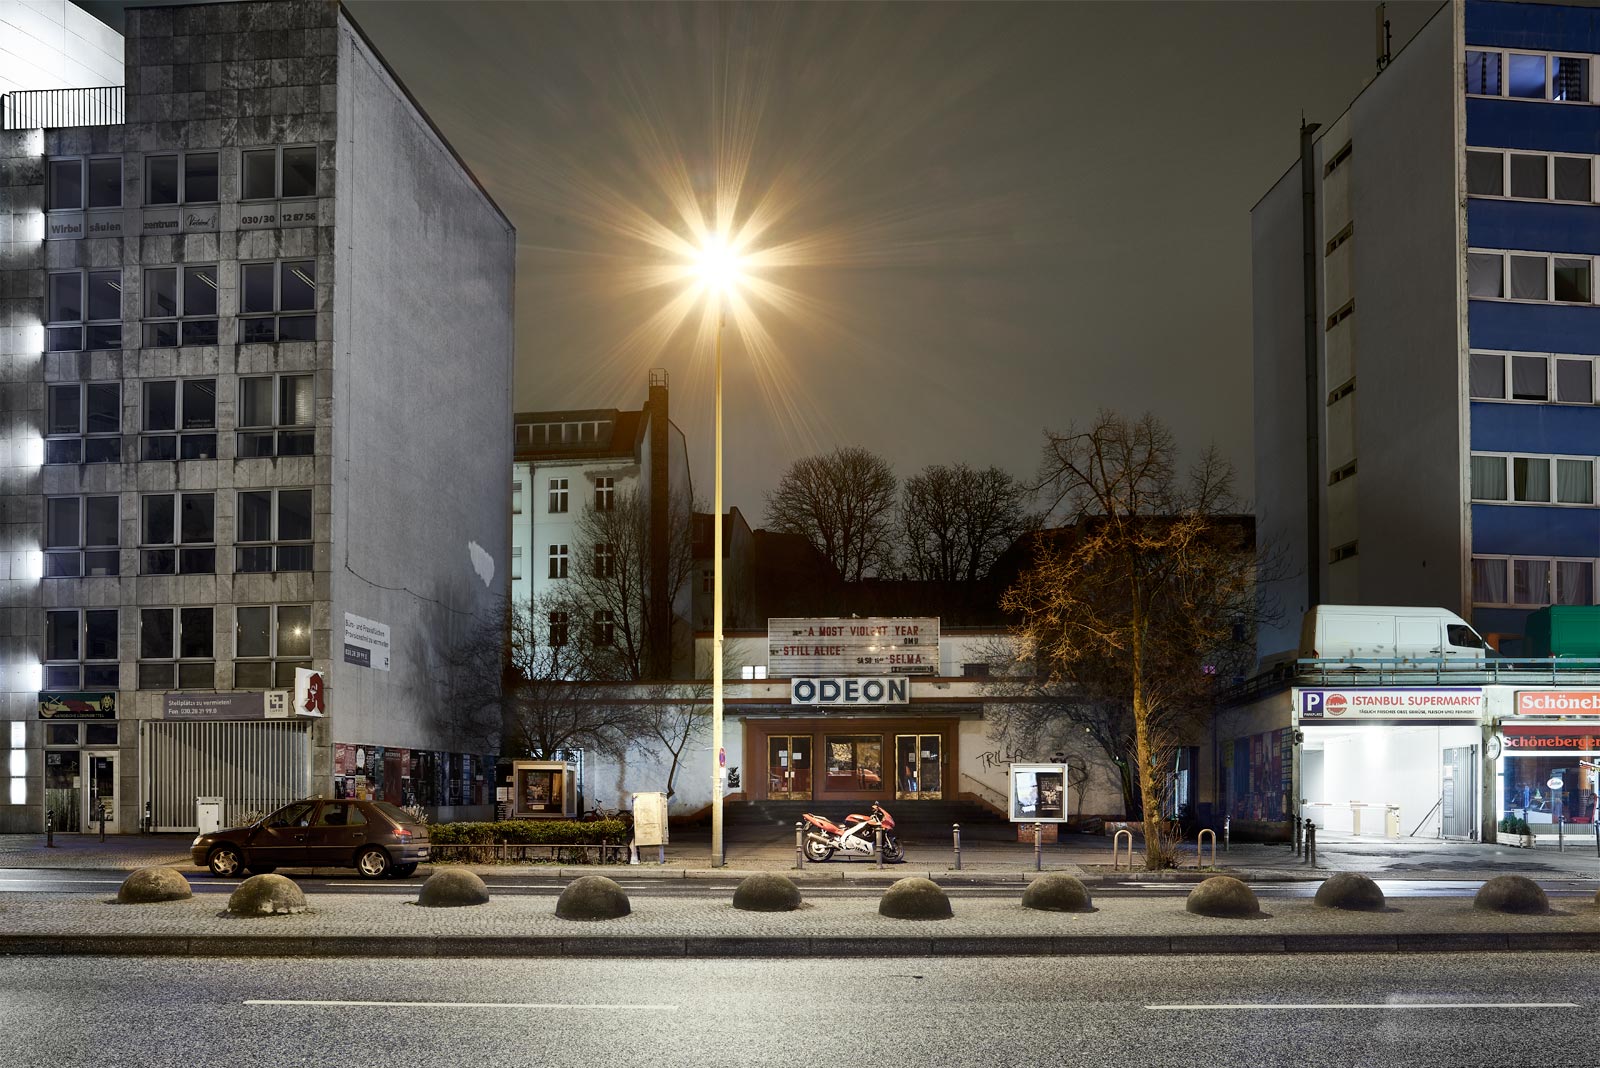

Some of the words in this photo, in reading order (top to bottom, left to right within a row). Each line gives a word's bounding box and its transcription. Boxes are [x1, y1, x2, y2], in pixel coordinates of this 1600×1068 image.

[241, 214, 275, 224] 030/30
[282, 213, 292, 222] 12
[293, 213, 304, 222] 87
[305, 211, 316, 221] 56
[51, 223, 81, 234] Wirbel
[89, 221, 121, 232] säulen
[143, 219, 178, 230] zentrum
[819, 626, 844, 636] MOST
[850, 625, 888, 636] VIOLENT
[895, 625, 919, 636] YEAR
[783, 646, 810, 656] STILL
[814, 646, 841, 656] ALICE
[889, 654, 922, 664] SELMA
[794, 679, 907, 702] ODEON
[1307, 693, 1320, 711] P
[1352, 696, 1404, 706] ISTANBUL
[1408, 696, 1481, 706] SUPERMARKT
